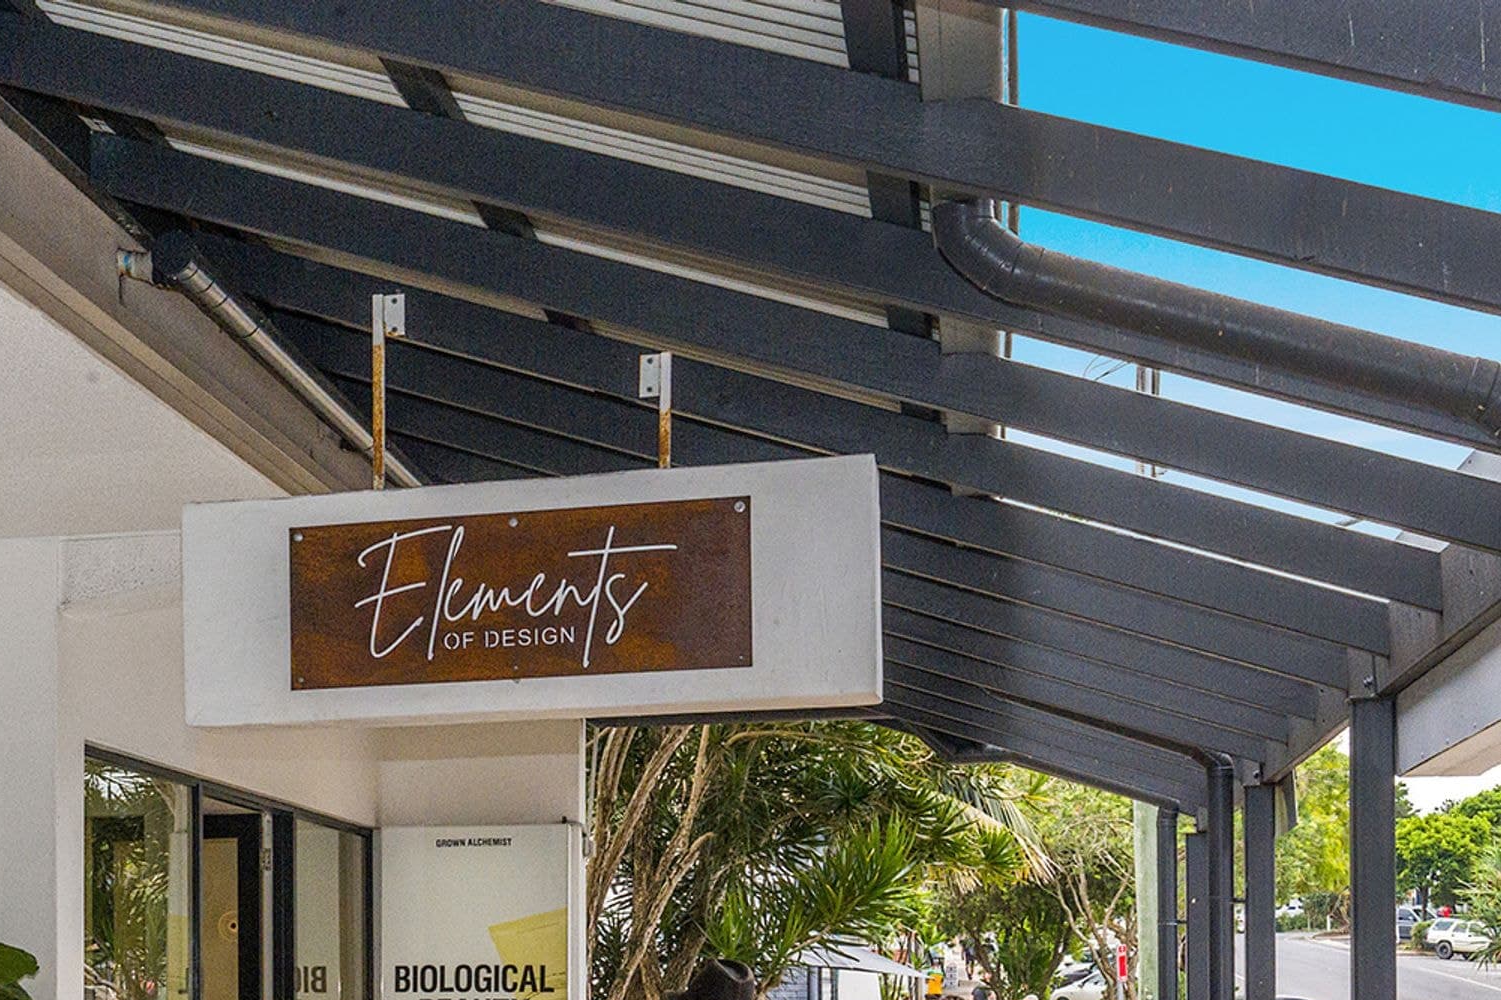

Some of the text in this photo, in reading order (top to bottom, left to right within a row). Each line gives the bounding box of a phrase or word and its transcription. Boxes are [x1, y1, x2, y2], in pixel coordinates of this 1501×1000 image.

[354, 525, 678, 669] Elements
[444, 626, 576, 651] OF DESIGN
[435, 837, 513, 848] GROWN ALCHEMIST
[394, 964, 555, 993] BIOLOGICAL
